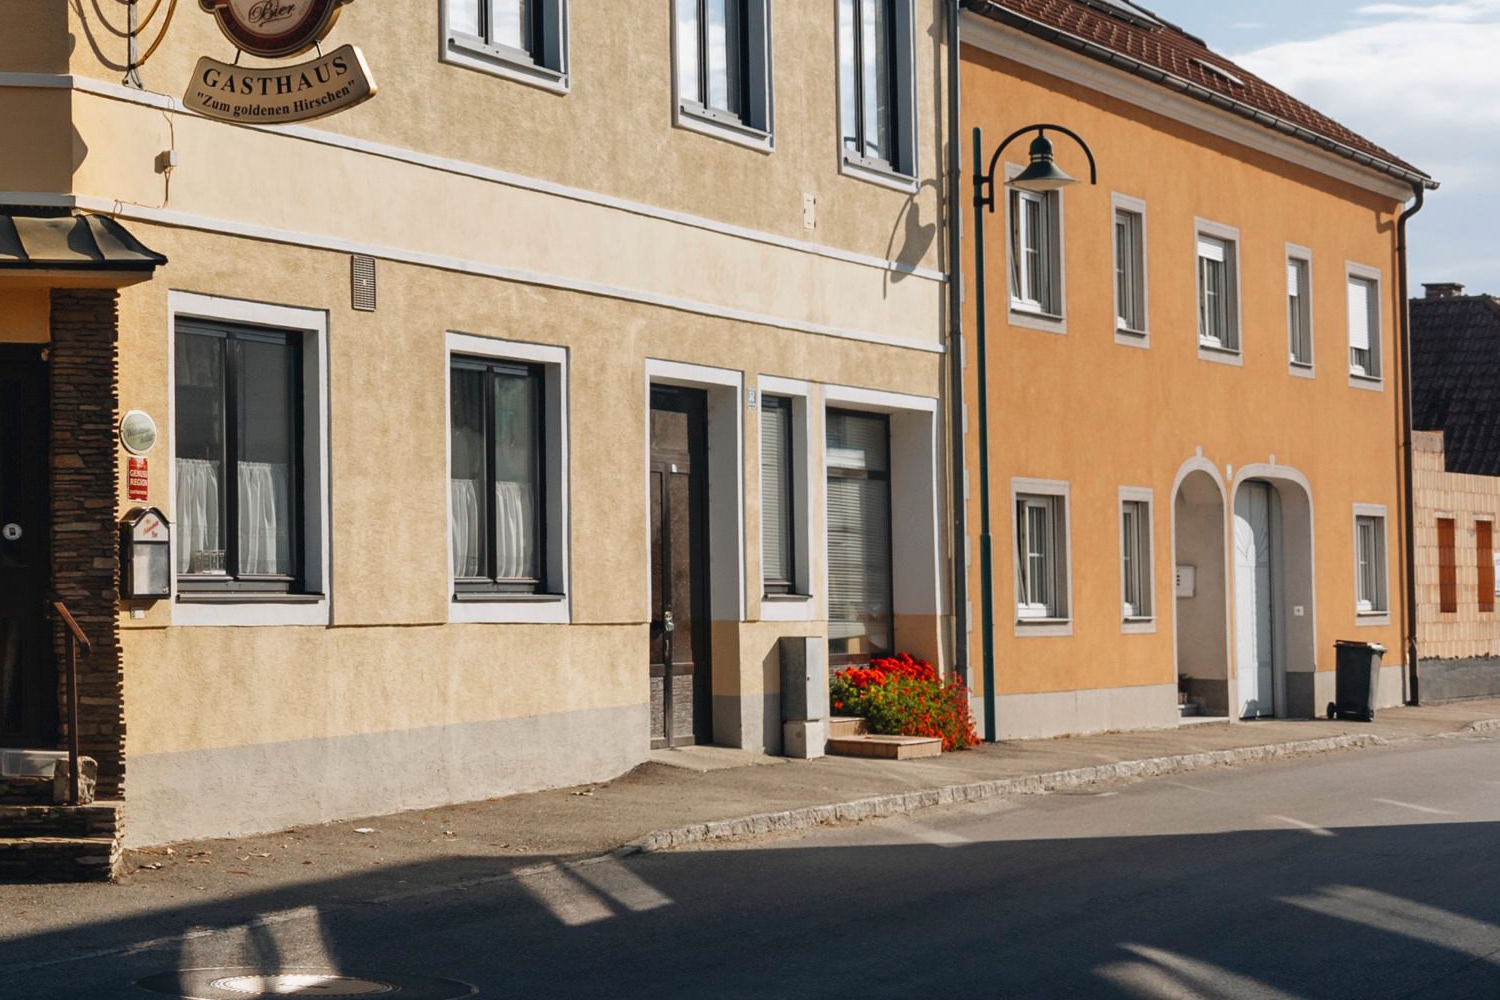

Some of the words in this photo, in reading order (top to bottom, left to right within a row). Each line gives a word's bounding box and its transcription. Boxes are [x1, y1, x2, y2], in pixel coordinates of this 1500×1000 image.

[249, 0, 295, 27] Bier
[202, 55, 348, 97] GASTHAUS
[197, 92, 231, 112] "Zum
[233, 102, 290, 117] goldenen
[293, 80, 355, 112] Hirschen"
